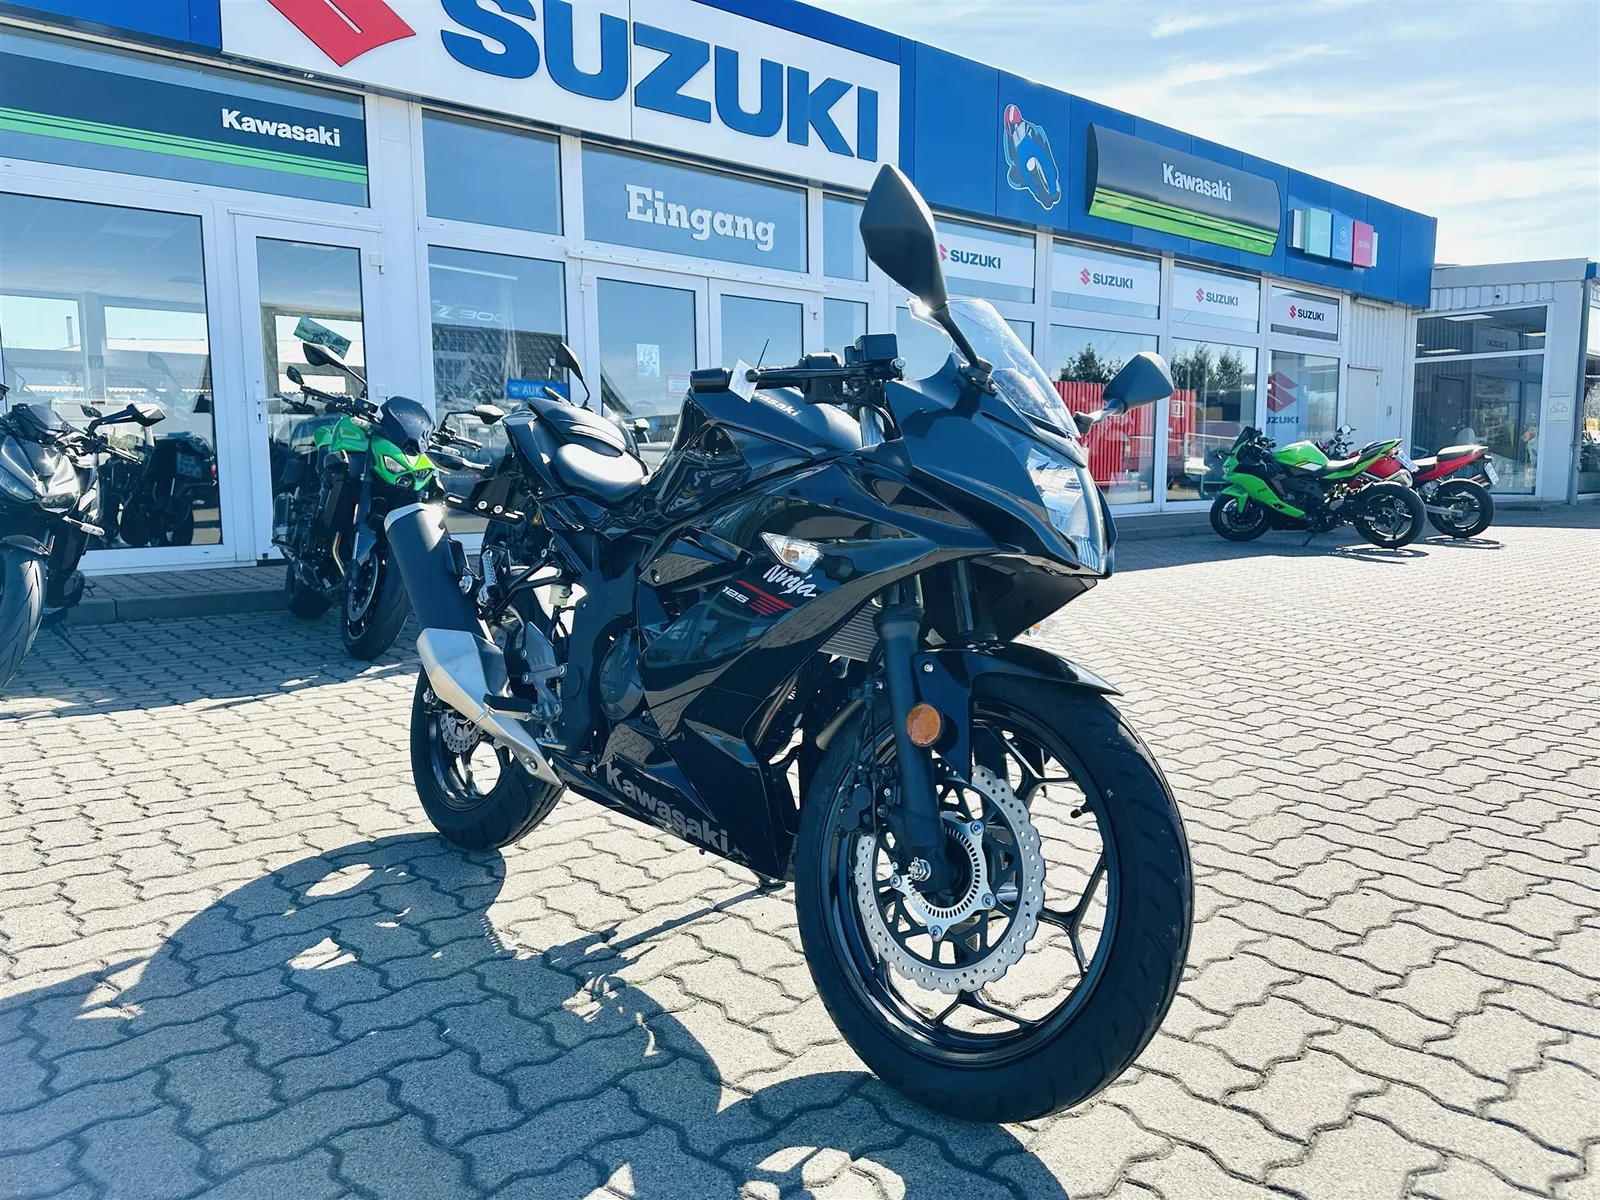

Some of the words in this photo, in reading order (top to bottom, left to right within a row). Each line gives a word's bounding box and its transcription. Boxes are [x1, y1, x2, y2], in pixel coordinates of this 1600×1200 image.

[441, 0, 878, 163] SUZUKI
[221, 108, 341, 147] Kawasaki
[1162, 162, 1232, 202] Kawasaki
[625, 184, 775, 252] Eingang
[950, 249, 1001, 269] SUZUKI
[1092, 272, 1133, 290] SUZUKI
[1205, 291, 1238, 307] SUZUKI
[1297, 308, 1325, 321] SUZUKI
[721, 585, 750, 604] 125
[762, 564, 817, 598] Ninja
[606, 761, 728, 854] Kawasaki
